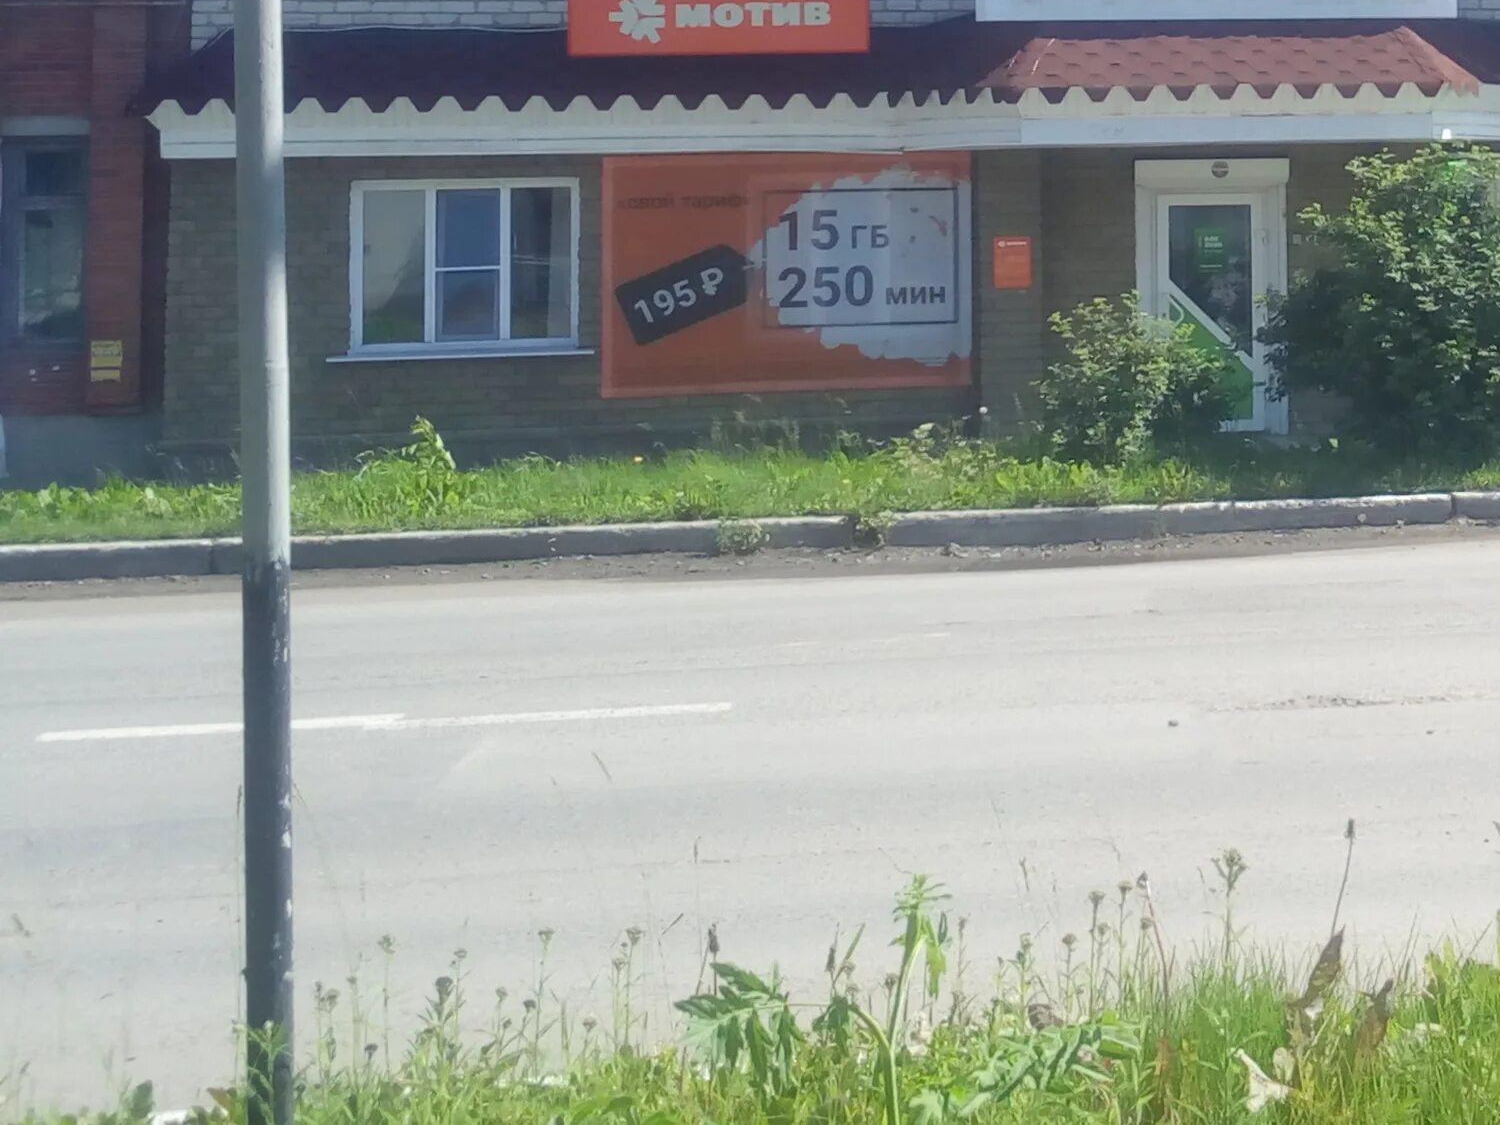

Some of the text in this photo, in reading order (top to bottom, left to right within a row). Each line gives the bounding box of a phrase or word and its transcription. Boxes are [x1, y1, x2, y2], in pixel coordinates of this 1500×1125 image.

[675, 1, 831, 28] МОТИВ
[778, 210, 889, 251] 15 ГБ
[633, 284, 697, 324] 195
[778, 266, 874, 308] 250
